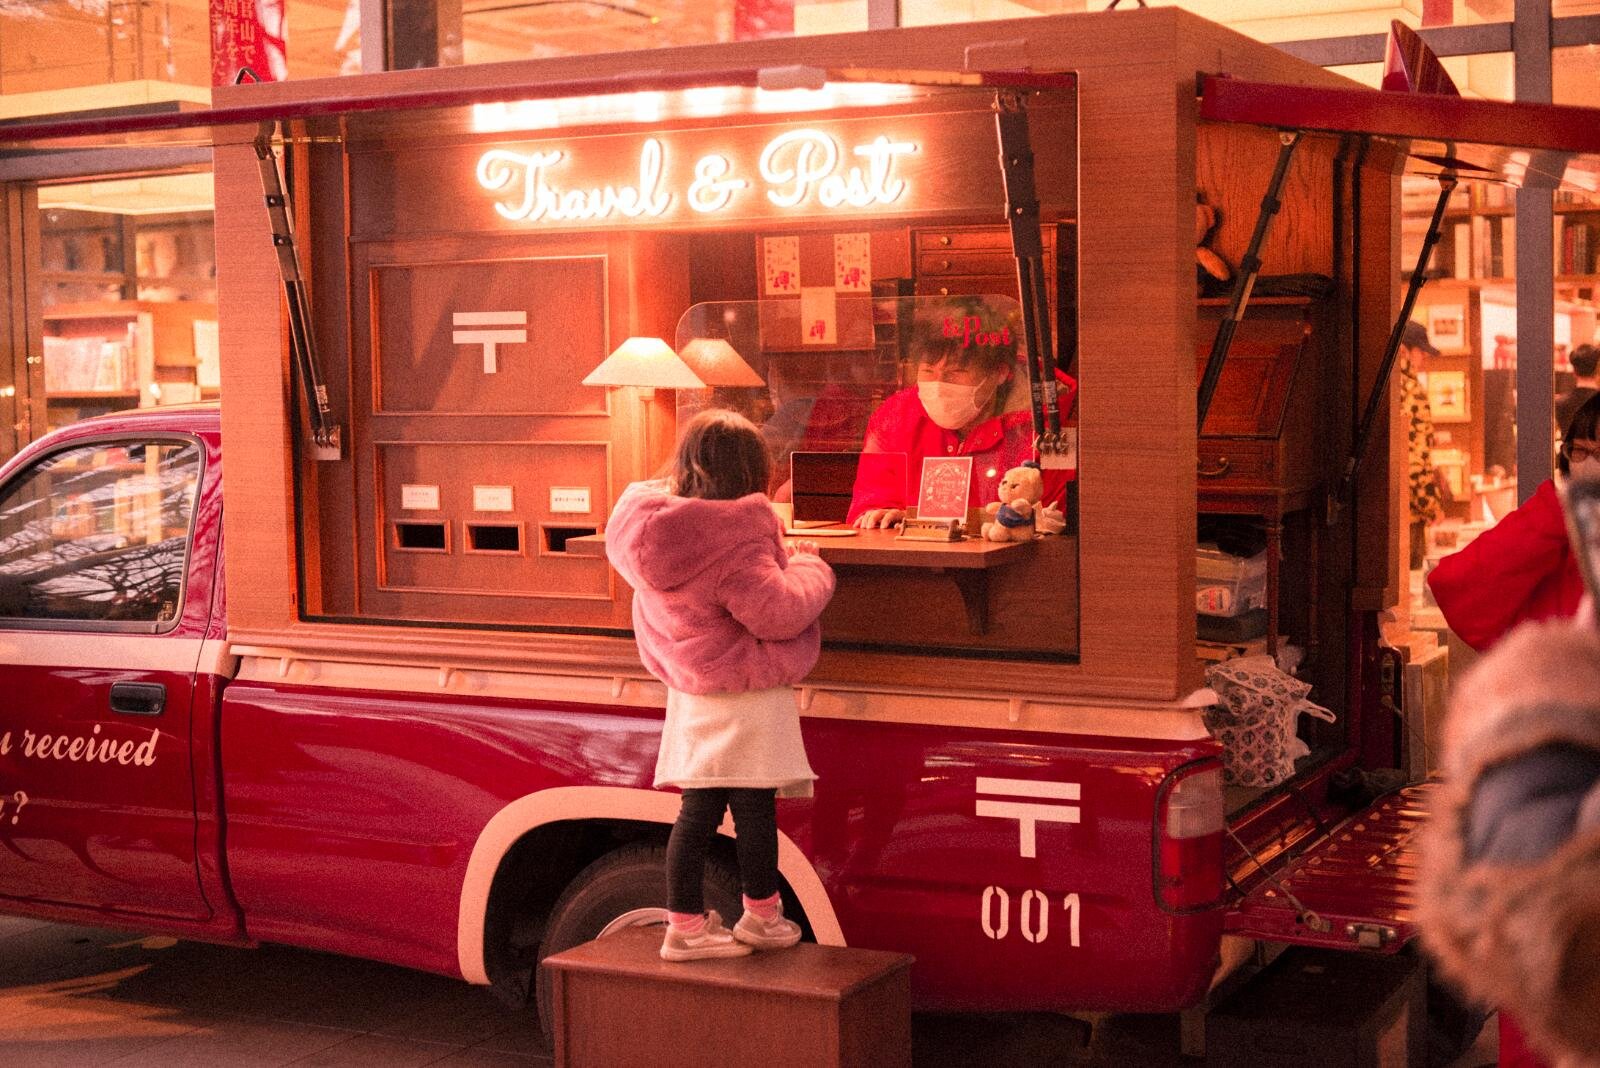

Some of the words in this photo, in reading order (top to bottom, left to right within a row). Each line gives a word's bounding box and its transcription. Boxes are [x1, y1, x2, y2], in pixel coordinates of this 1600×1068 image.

[476, 137, 673, 222] Travel
[687, 154, 750, 213] &
[759, 128, 918, 208] Post
[20, 723, 160, 767] received
[981, 885, 1081, 948] 001
